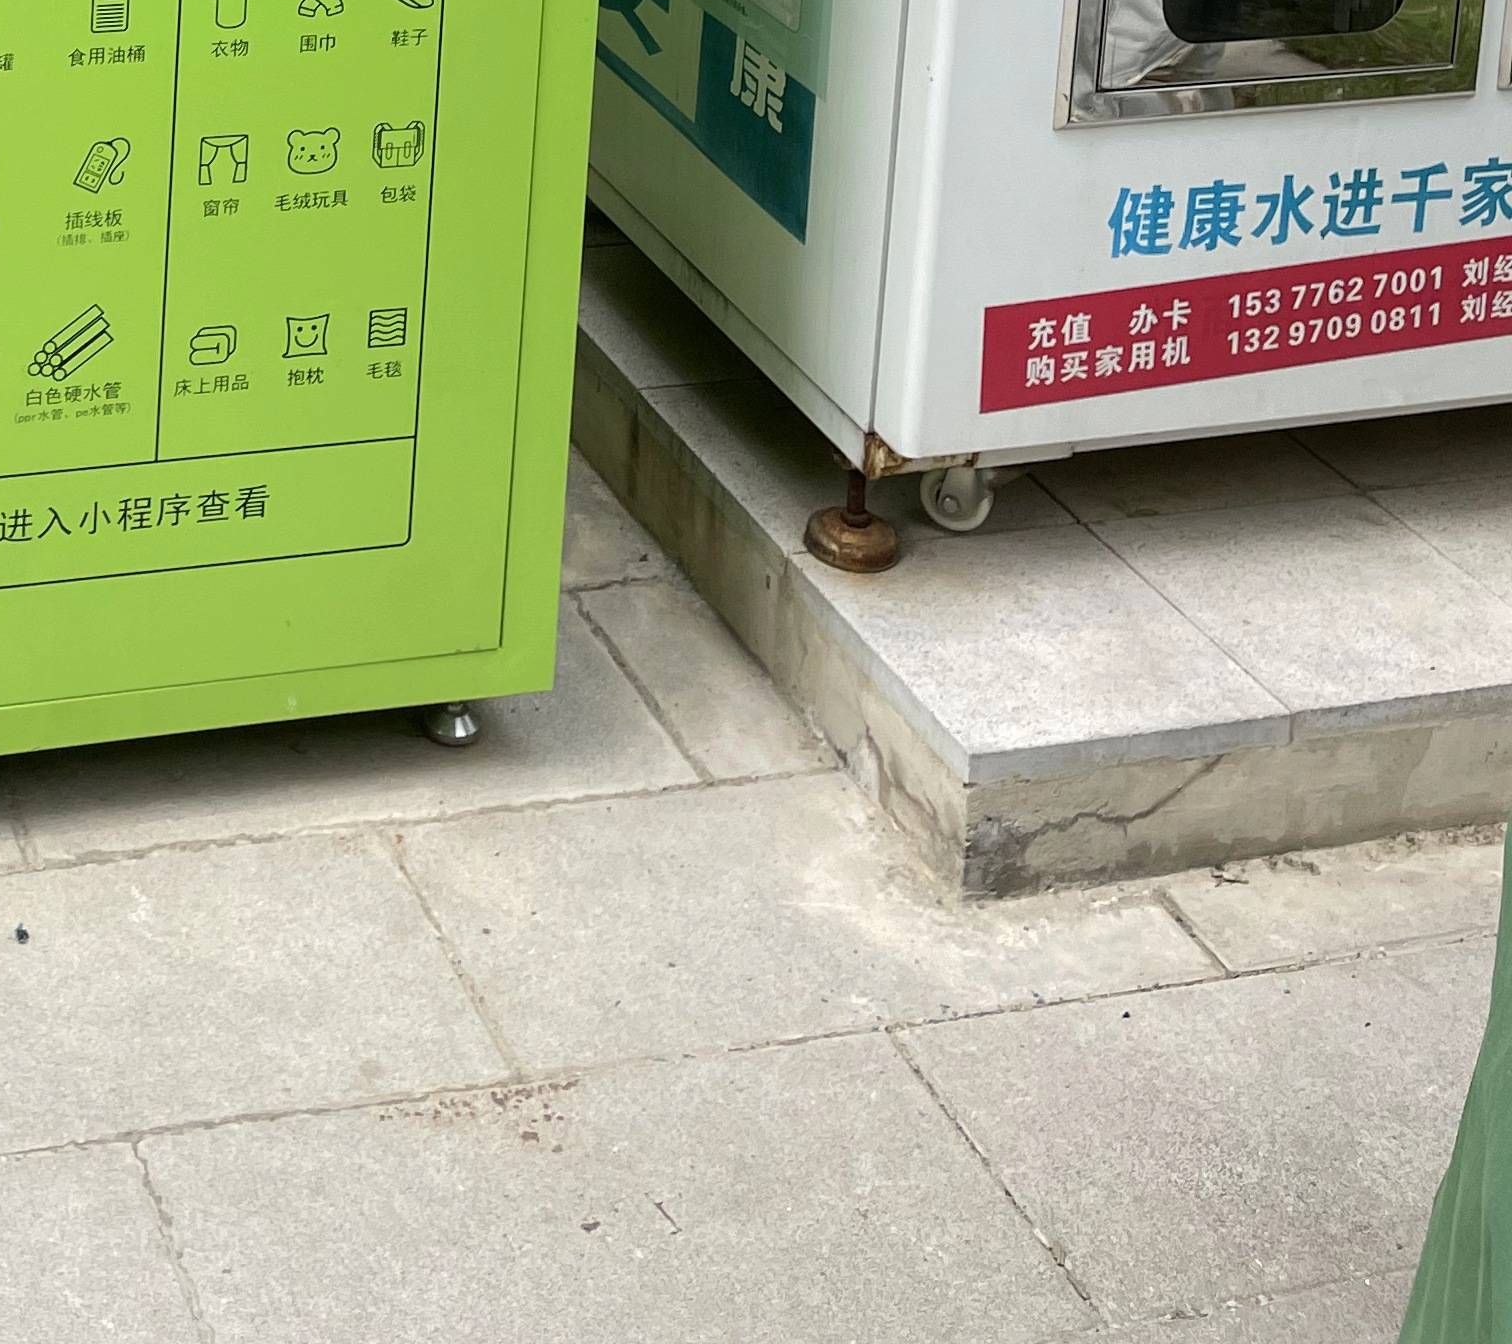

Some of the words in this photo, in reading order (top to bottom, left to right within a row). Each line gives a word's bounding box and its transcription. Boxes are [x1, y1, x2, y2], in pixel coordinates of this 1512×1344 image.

[211, 37, 250, 59] 衣物
[299, 34, 337, 54] 围巾
[390, 27, 429, 49] 鞋子
[68, 44, 147, 68] 食用油桶
[274, 189, 349, 213] 毛绒玩具
[380, 184, 418, 205] 包袋
[202, 197, 241, 218] 窗帘
[1107, 156, 1512, 259] 健康水进千家
[65, 209, 123, 230] 插线板
[1028, 313, 1092, 352] 充值
[1129, 298, 1192, 335] 办卡
[1228, 290, 1282, 320] 153
[1291, 276, 1363, 312] 7762
[1373, 265, 1444, 301] 7001
[1025, 336, 1192, 389] 购买家用机
[1227, 325, 1280, 356] 132
[1289, 313, 1361, 348] 9709
[1370, 301, 1442, 337] 0811
[287, 366, 325, 388] 抱枕
[366, 360, 403, 381] 毛毯
[25, 381, 123, 408] 白色硬水管
[174, 373, 250, 397] 床上用品
